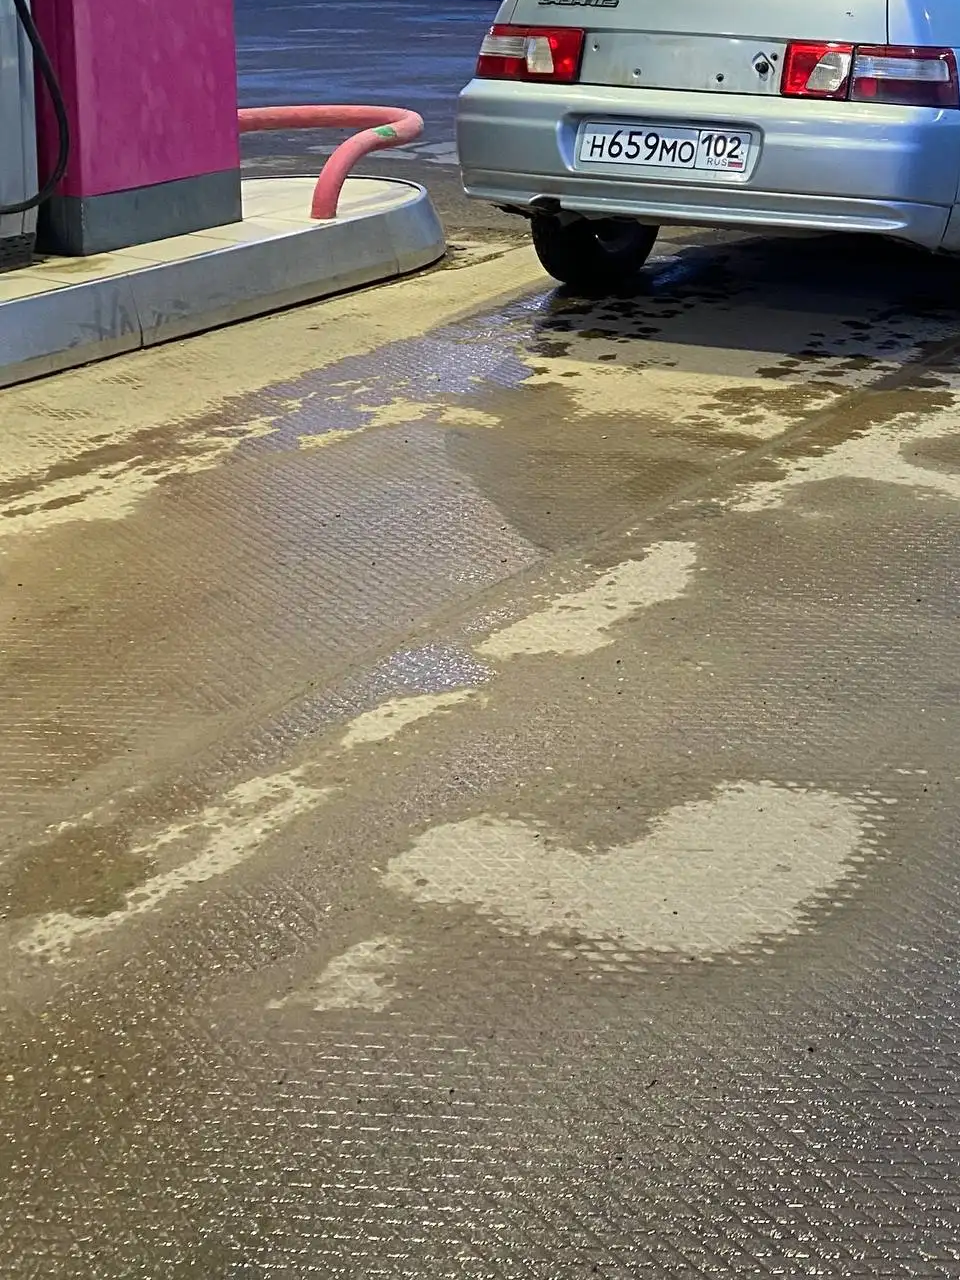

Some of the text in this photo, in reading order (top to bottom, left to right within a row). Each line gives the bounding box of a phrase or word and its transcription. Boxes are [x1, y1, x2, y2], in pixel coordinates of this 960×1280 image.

[589, 130, 742, 163] Н659МО 102
[706, 157, 727, 167] RUS
